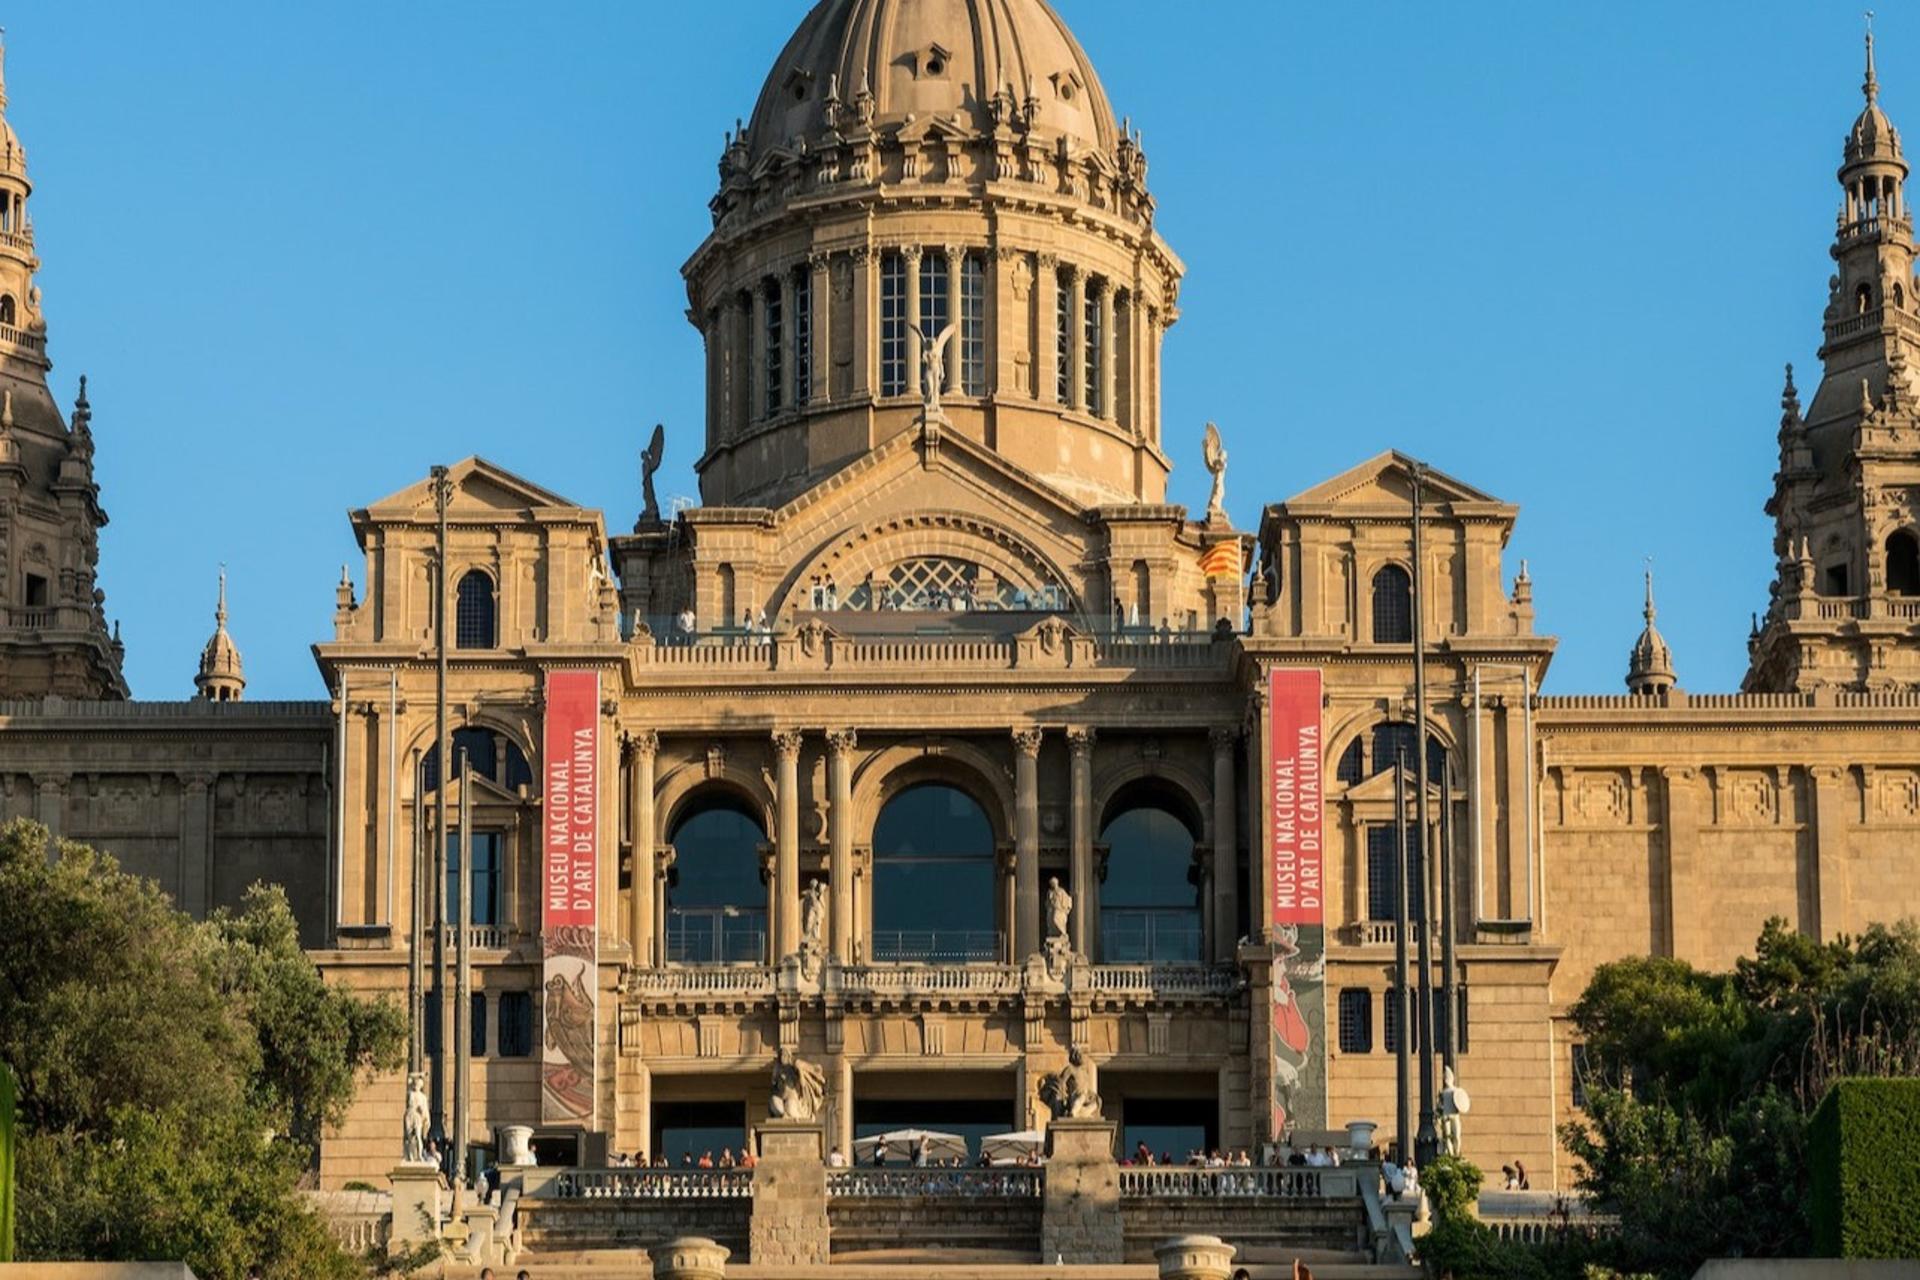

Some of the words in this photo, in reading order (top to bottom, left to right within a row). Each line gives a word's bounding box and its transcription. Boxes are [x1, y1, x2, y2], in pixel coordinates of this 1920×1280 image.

[551, 759, 569, 846] NACIONAL
[574, 727, 593, 825] CATALUNYA
[1277, 757, 1295, 843] NACIONAL
[1299, 725, 1318, 823] CATALUNYA
[574, 830, 592, 851] DE
[1300, 829, 1319, 850] DE
[550, 852, 569, 911] MUSEU
[573, 860, 592, 910] D'ART
[1277, 850, 1296, 908] MUSEU
[1301, 858, 1319, 908] D'ART
